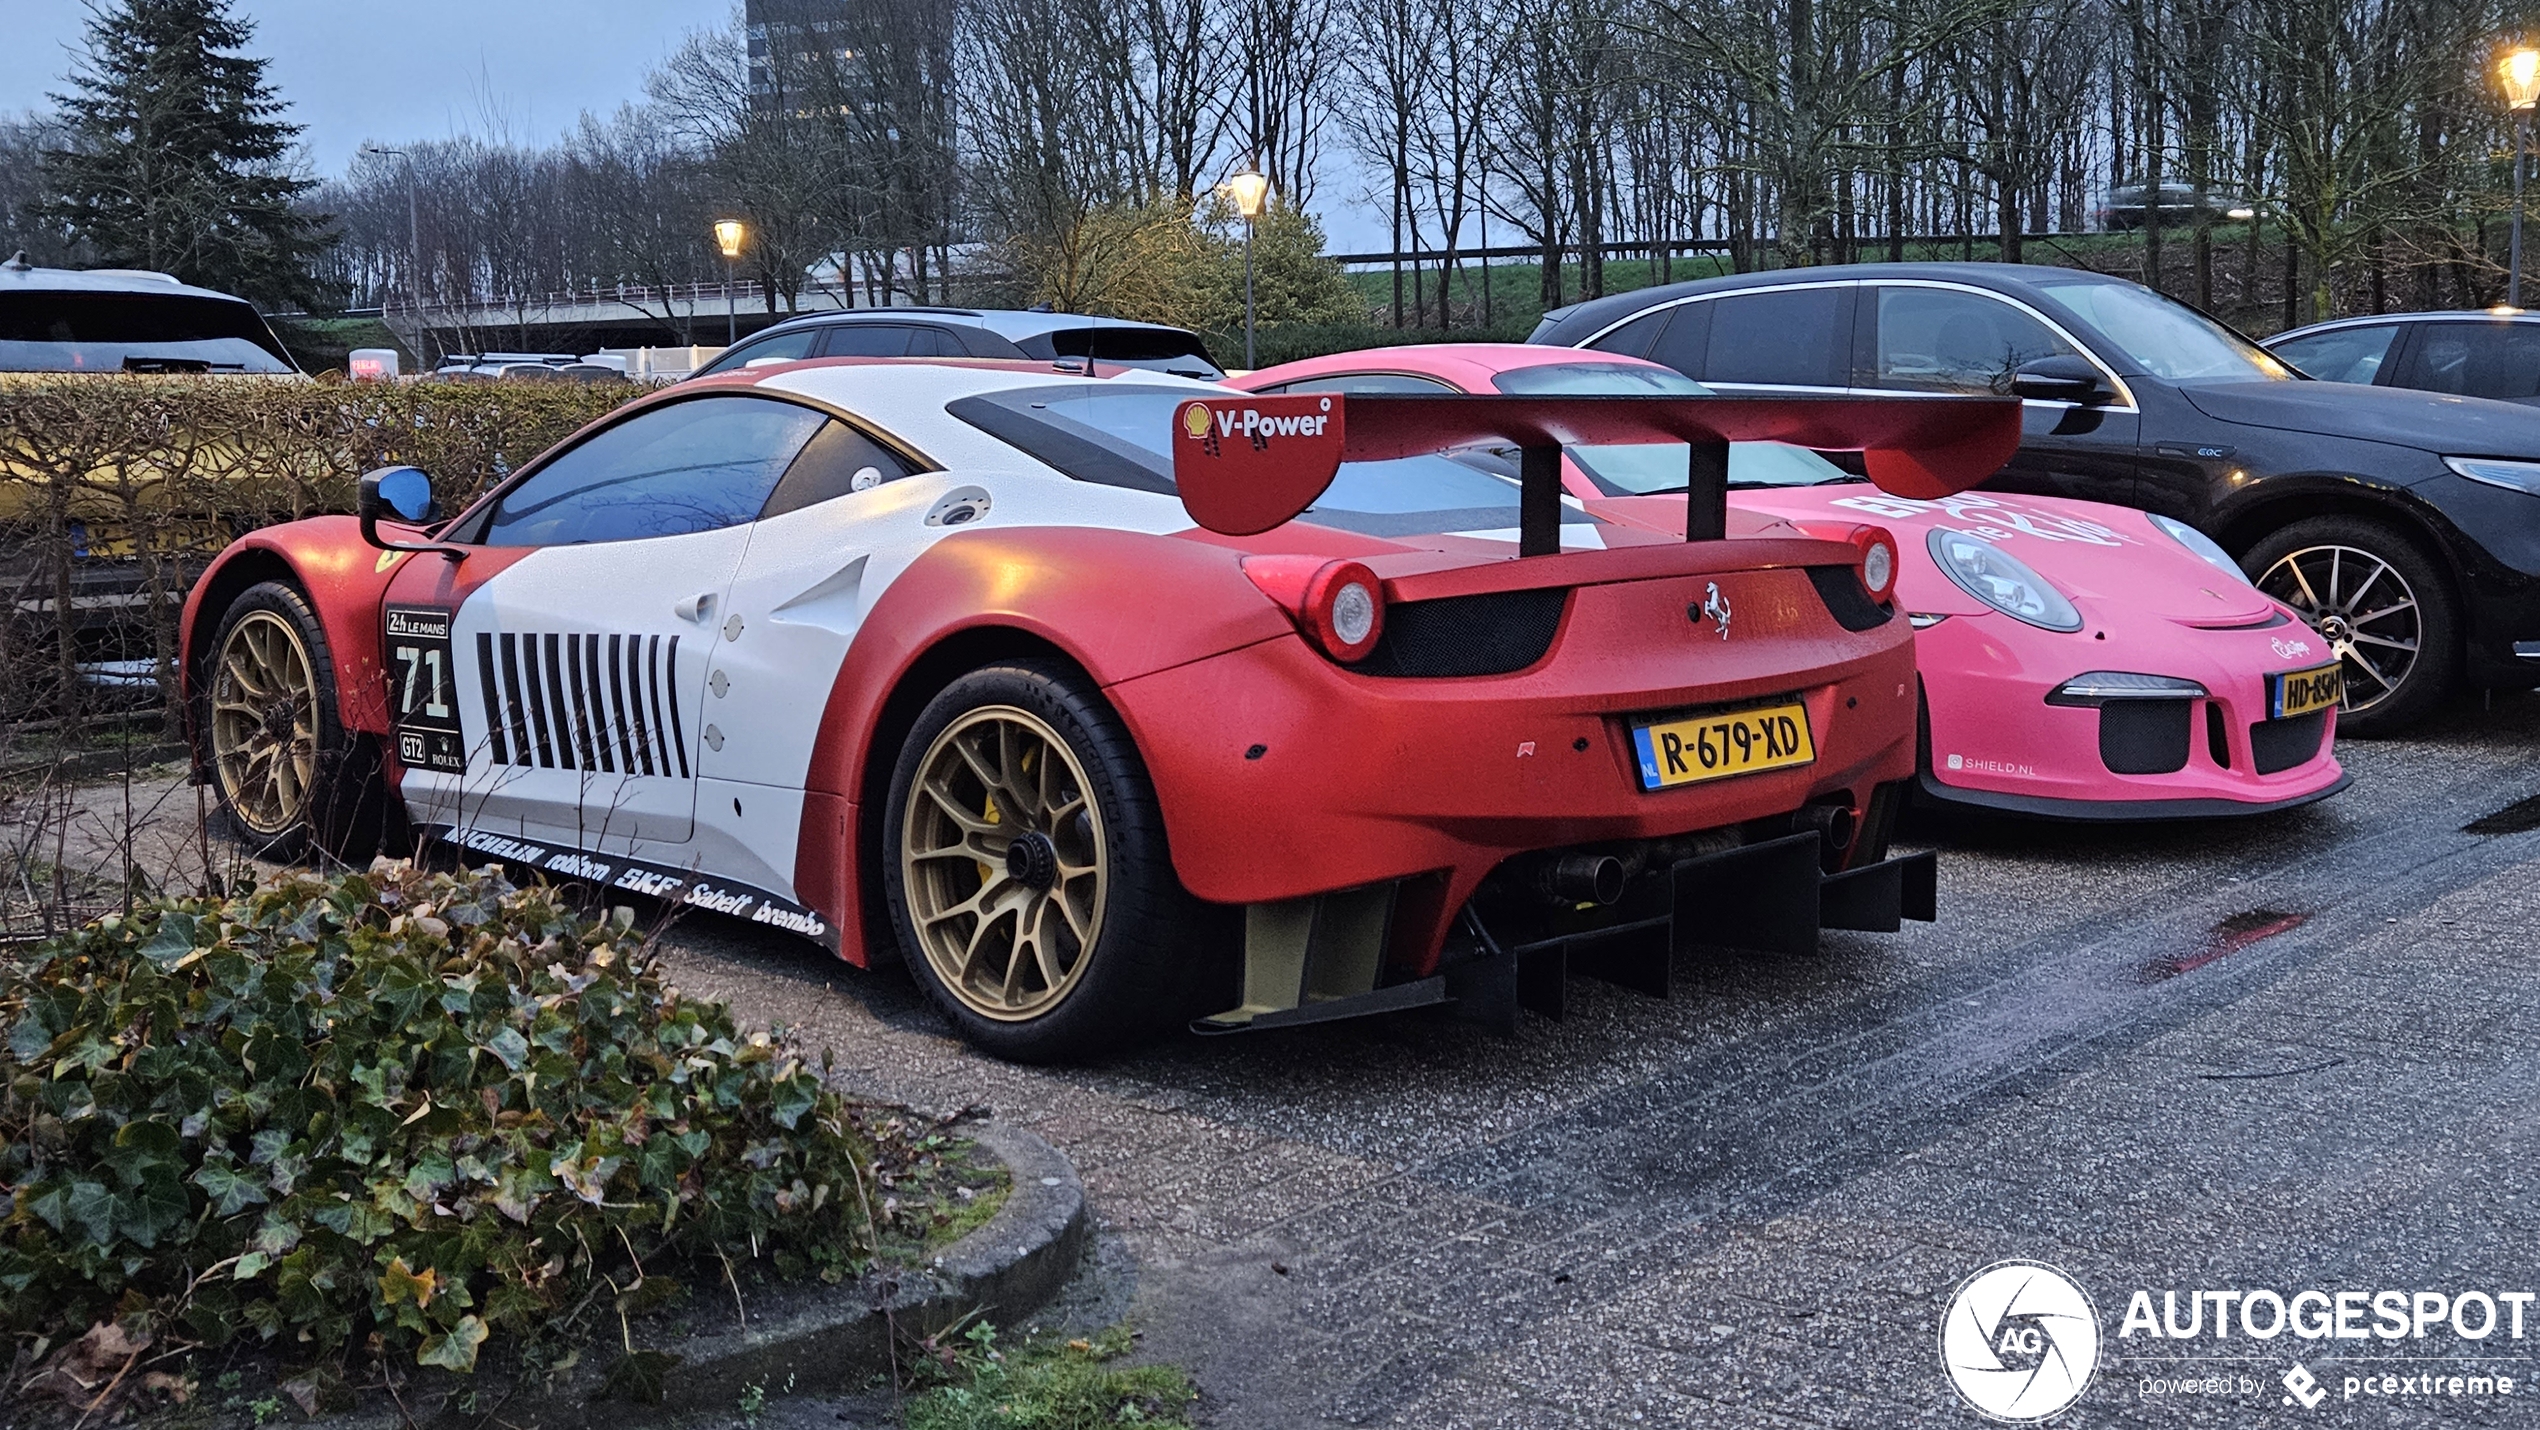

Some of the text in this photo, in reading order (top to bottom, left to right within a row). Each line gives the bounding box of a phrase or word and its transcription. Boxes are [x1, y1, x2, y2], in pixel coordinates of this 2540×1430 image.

[2197, 447, 2223, 457] EQC
[407, 622, 419, 633] LE
[419, 623, 446, 635] MANS
[396, 646, 449, 718] 71
[401, 736, 423, 759] GT2
[1641, 715, 1800, 777] NL R-679-XD
[432, 753, 461, 768] ROLEX
[1965, 758, 2036, 776] SHIELD.NL
[442, 825, 546, 864] MICHELIN
[614, 867, 683, 896] SKF
[683, 883, 753, 916] Sabelt
[752, 900, 825, 936] brembo
